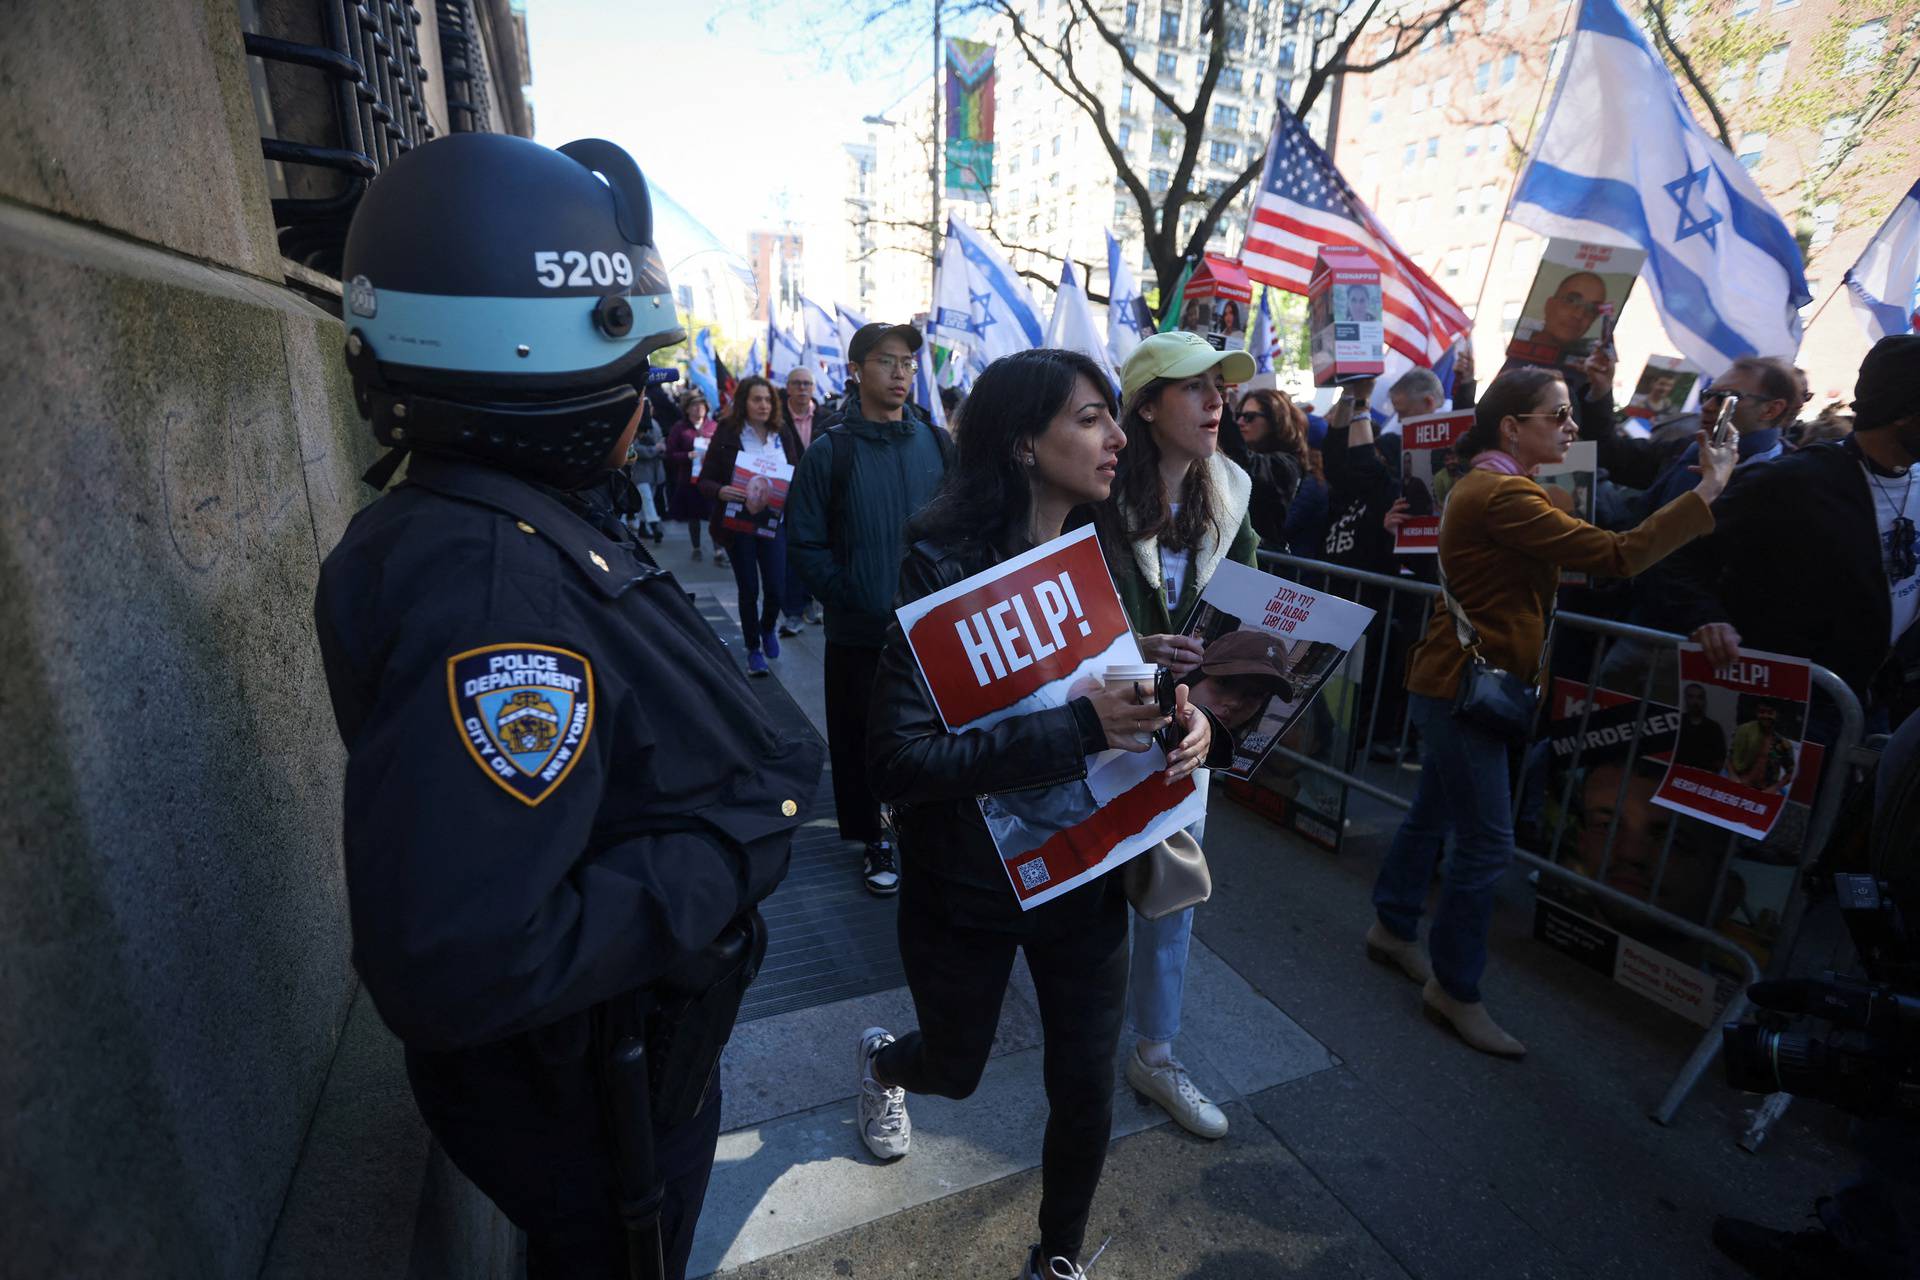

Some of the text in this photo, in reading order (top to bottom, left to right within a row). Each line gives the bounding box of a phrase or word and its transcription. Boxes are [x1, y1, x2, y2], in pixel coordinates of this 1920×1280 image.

[534, 250, 634, 288] 5209
[1416, 422, 1450, 444] HELP!
[954, 570, 1093, 687] HELP!
[1265, 599, 1310, 622] LIRI ALBAG
[489, 654, 559, 673] POLICE
[464, 669, 582, 697] DEPARTMENT
[465, 717, 517, 778] CITY OF
[541, 701, 588, 781] NEW YORK
[1552, 711, 1680, 756] MURDERED
